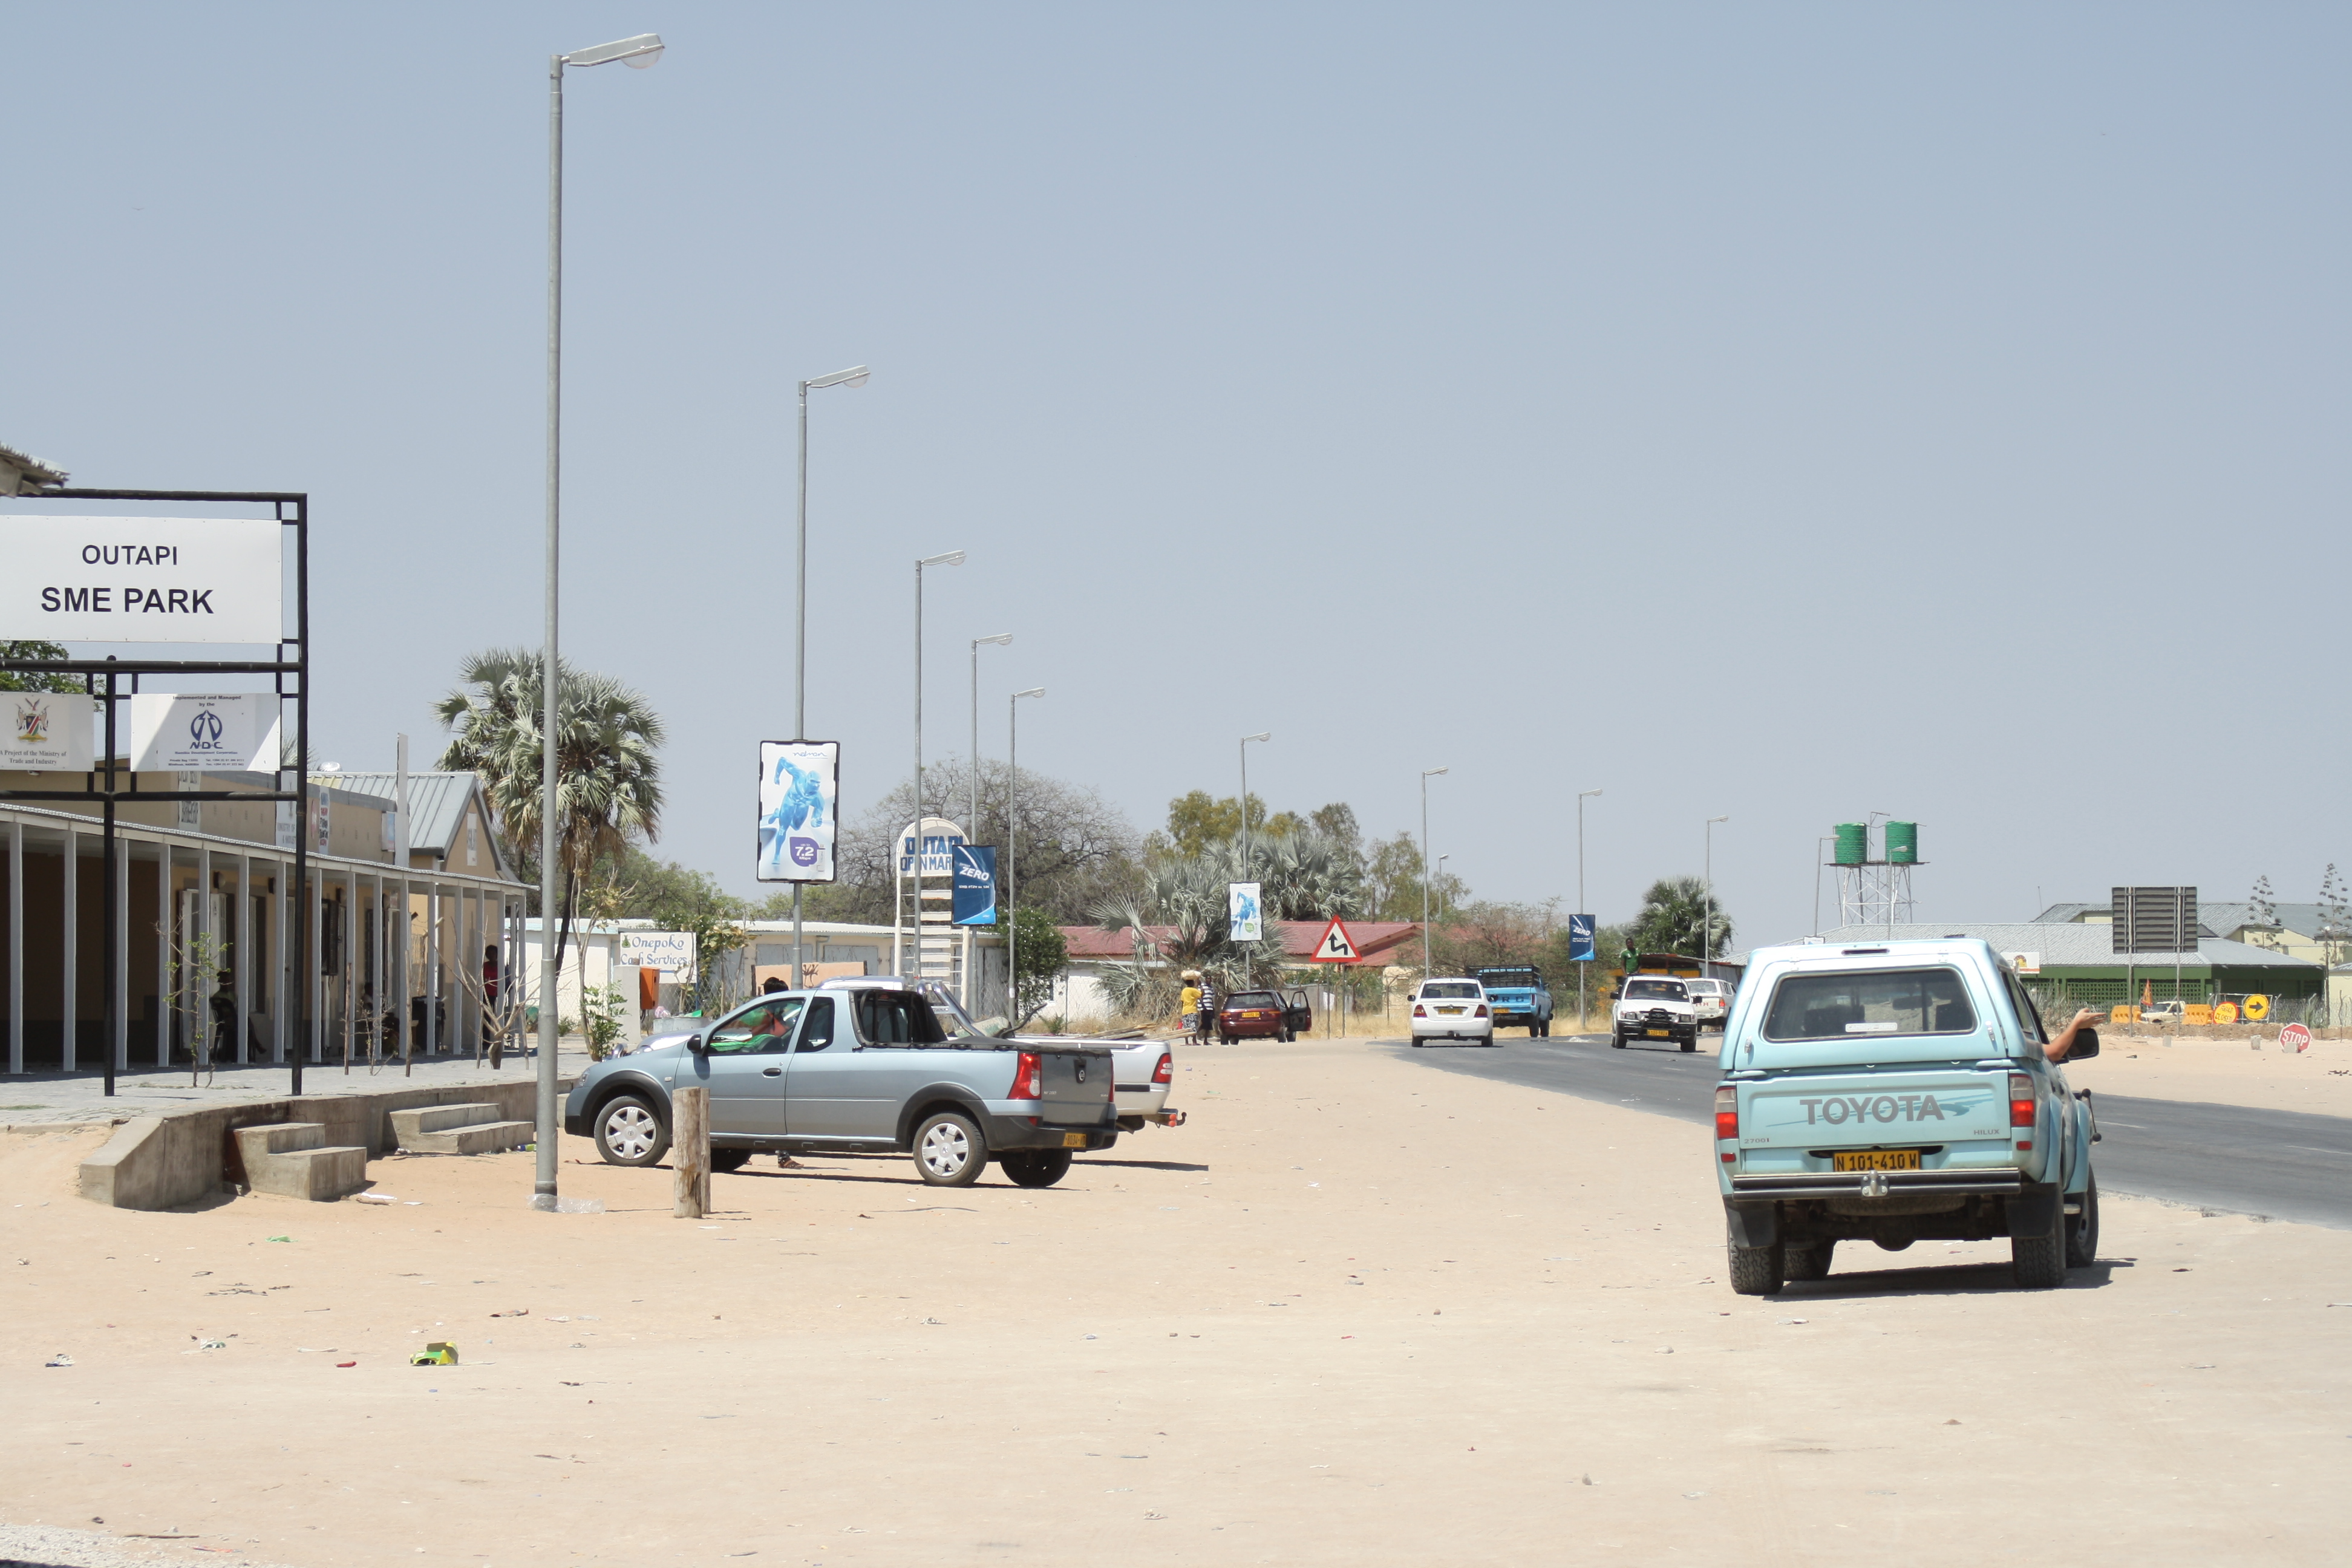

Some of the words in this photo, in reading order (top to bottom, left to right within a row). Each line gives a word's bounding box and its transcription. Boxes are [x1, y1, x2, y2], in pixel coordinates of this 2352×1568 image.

[82, 544, 177, 566] OUTAPI
[41, 587, 111, 612] SME
[124, 588, 214, 614] PARK
[795, 846, 814, 857] 7.2
[901, 857, 927, 871] OPN
[929, 857, 952, 871] MAR
[959, 867, 990, 881] ZERO
[1573, 926, 1591, 936] ZERO
[632, 935, 684, 953] Onepoko
[621, 952, 644, 965] Cah
[647, 953, 687, 965] Services
[2282, 1030, 2308, 1047] STOP
[1800, 1095, 1945, 1125] TOYOTA
